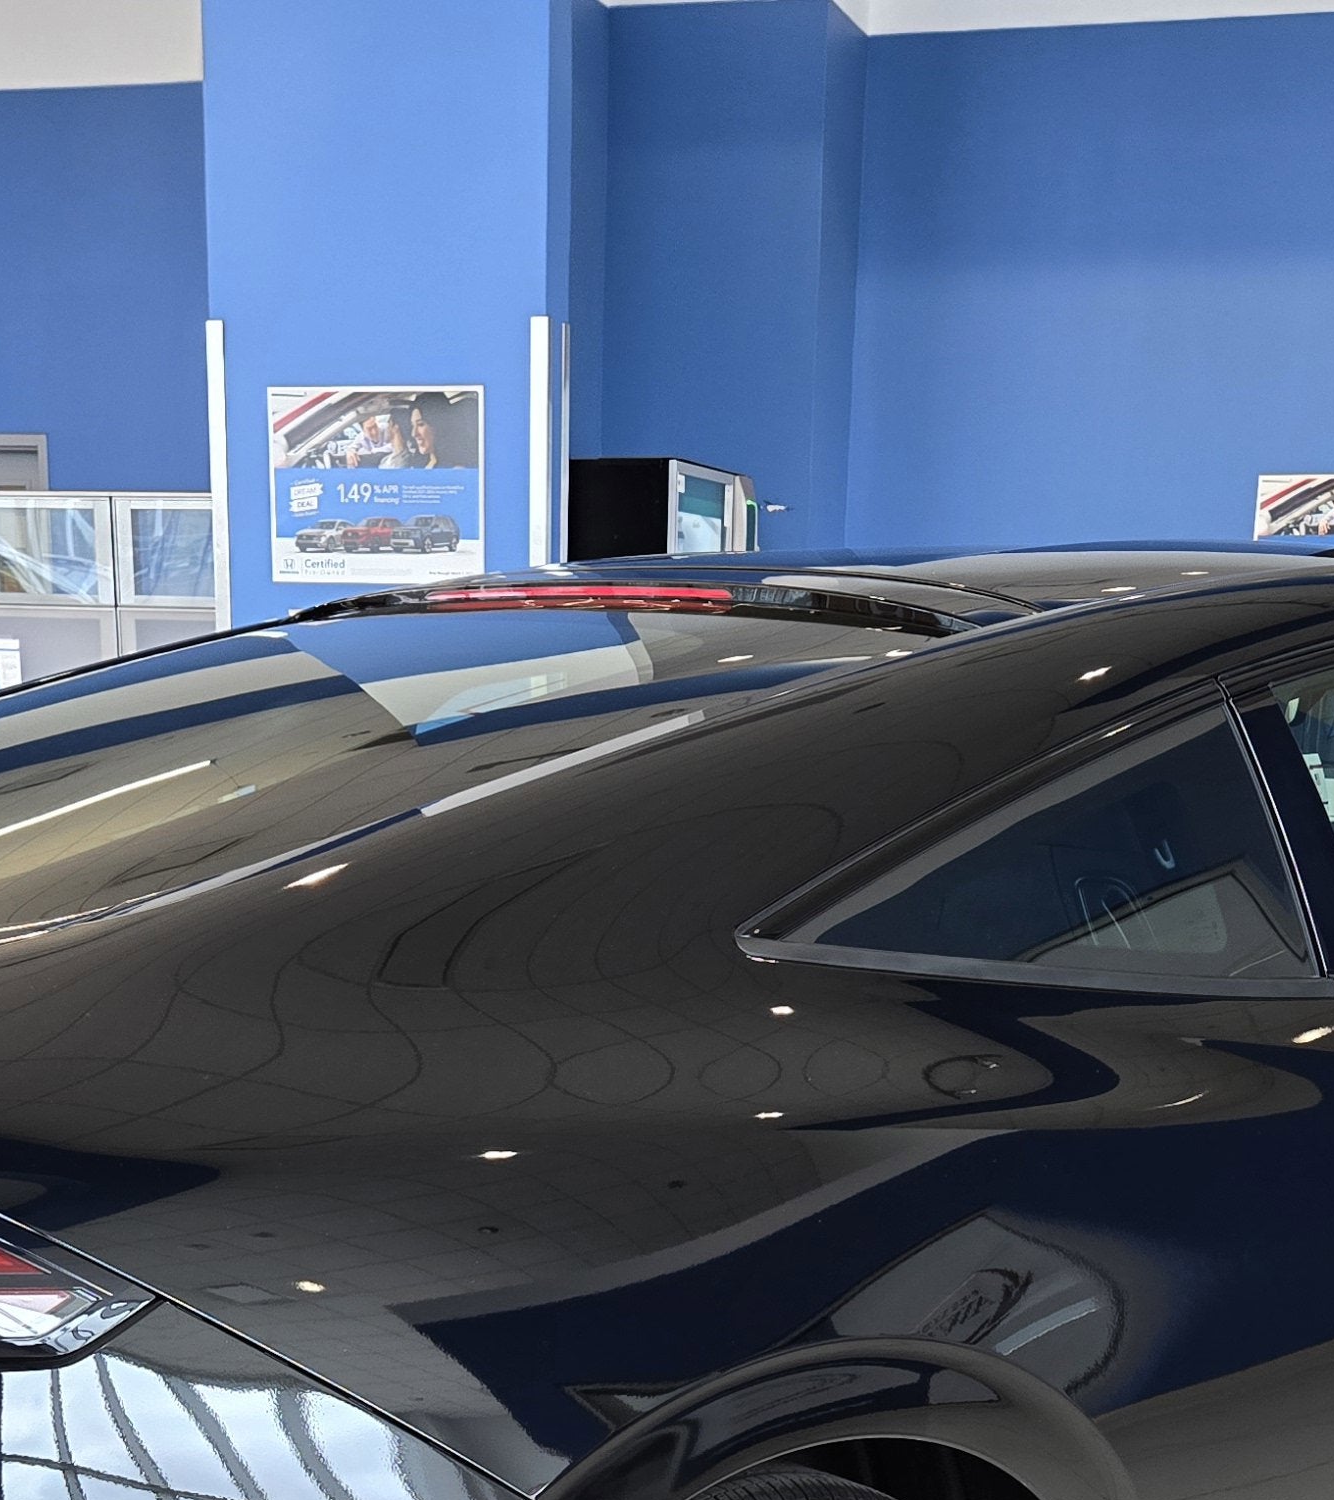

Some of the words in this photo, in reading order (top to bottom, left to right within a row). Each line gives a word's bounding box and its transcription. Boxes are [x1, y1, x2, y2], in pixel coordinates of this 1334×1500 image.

[336, 483, 372, 503] 1.49
[382, 485, 399, 494] APR
[304, 559, 345, 569] Certified
